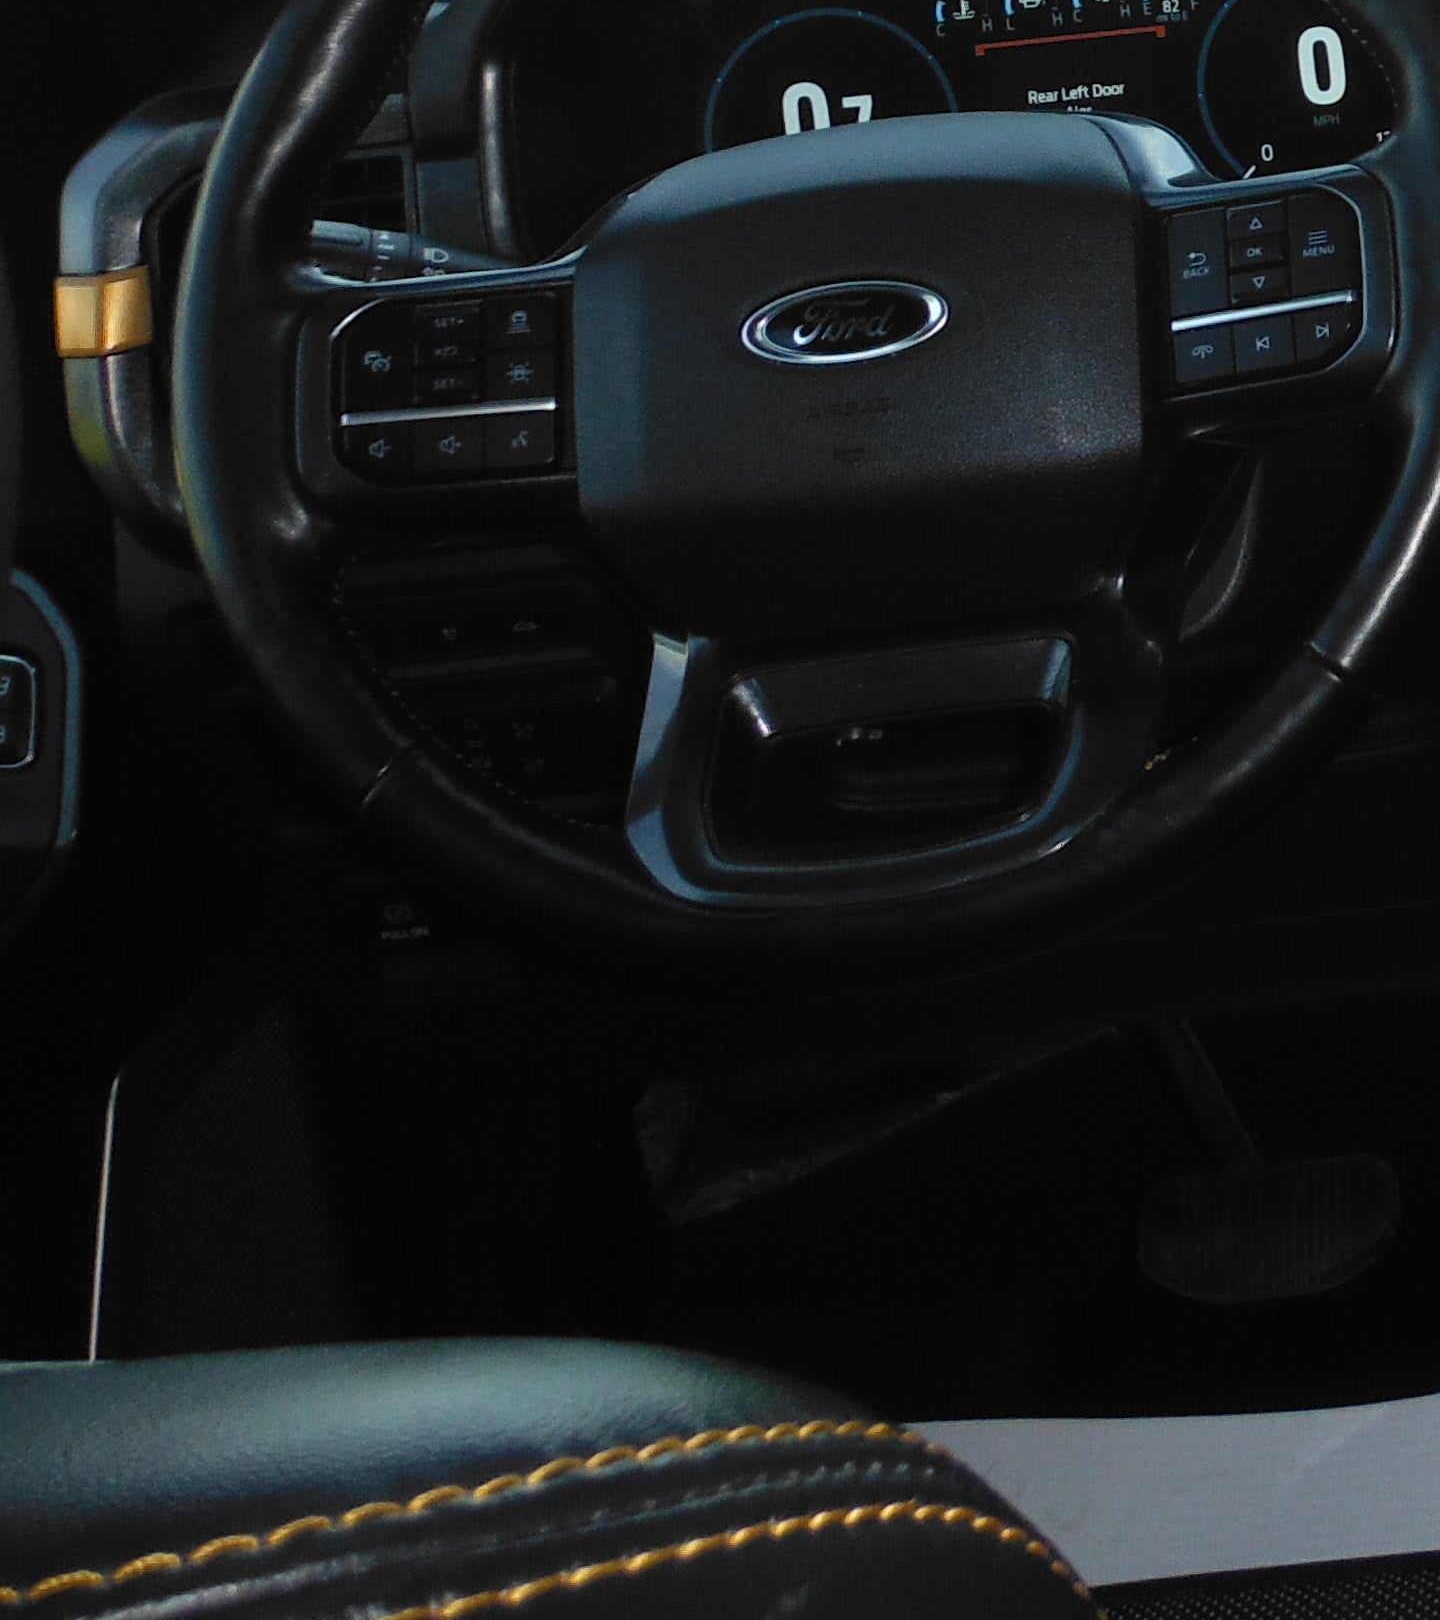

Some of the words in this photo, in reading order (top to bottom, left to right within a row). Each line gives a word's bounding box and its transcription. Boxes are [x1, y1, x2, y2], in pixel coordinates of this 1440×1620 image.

[1120, 5, 1131, 18] H
[1143, 2, 1153, 16] E
[1052, 13, 1063, 26] H
[1072, 11, 1083, 23] C
[935, 24, 946, 37] C
[981, 19, 993, 32] H
[1006, 18, 1015, 31] L
[1297, 25, 1347, 105] 0
[1027, 89, 1059, 105] Rear
[1061, 85, 1090, 101] Left
[1092, 83, 1126, 98] Door
[1313, 113, 1340, 127] MPH
[1260, 143, 1276, 162] 0
[1246, 246, 1264, 258] OK
[1302, 244, 1335, 258] MENU
[1182, 266, 1210, 280] BACK
[793, 296, 896, 347] Ford
